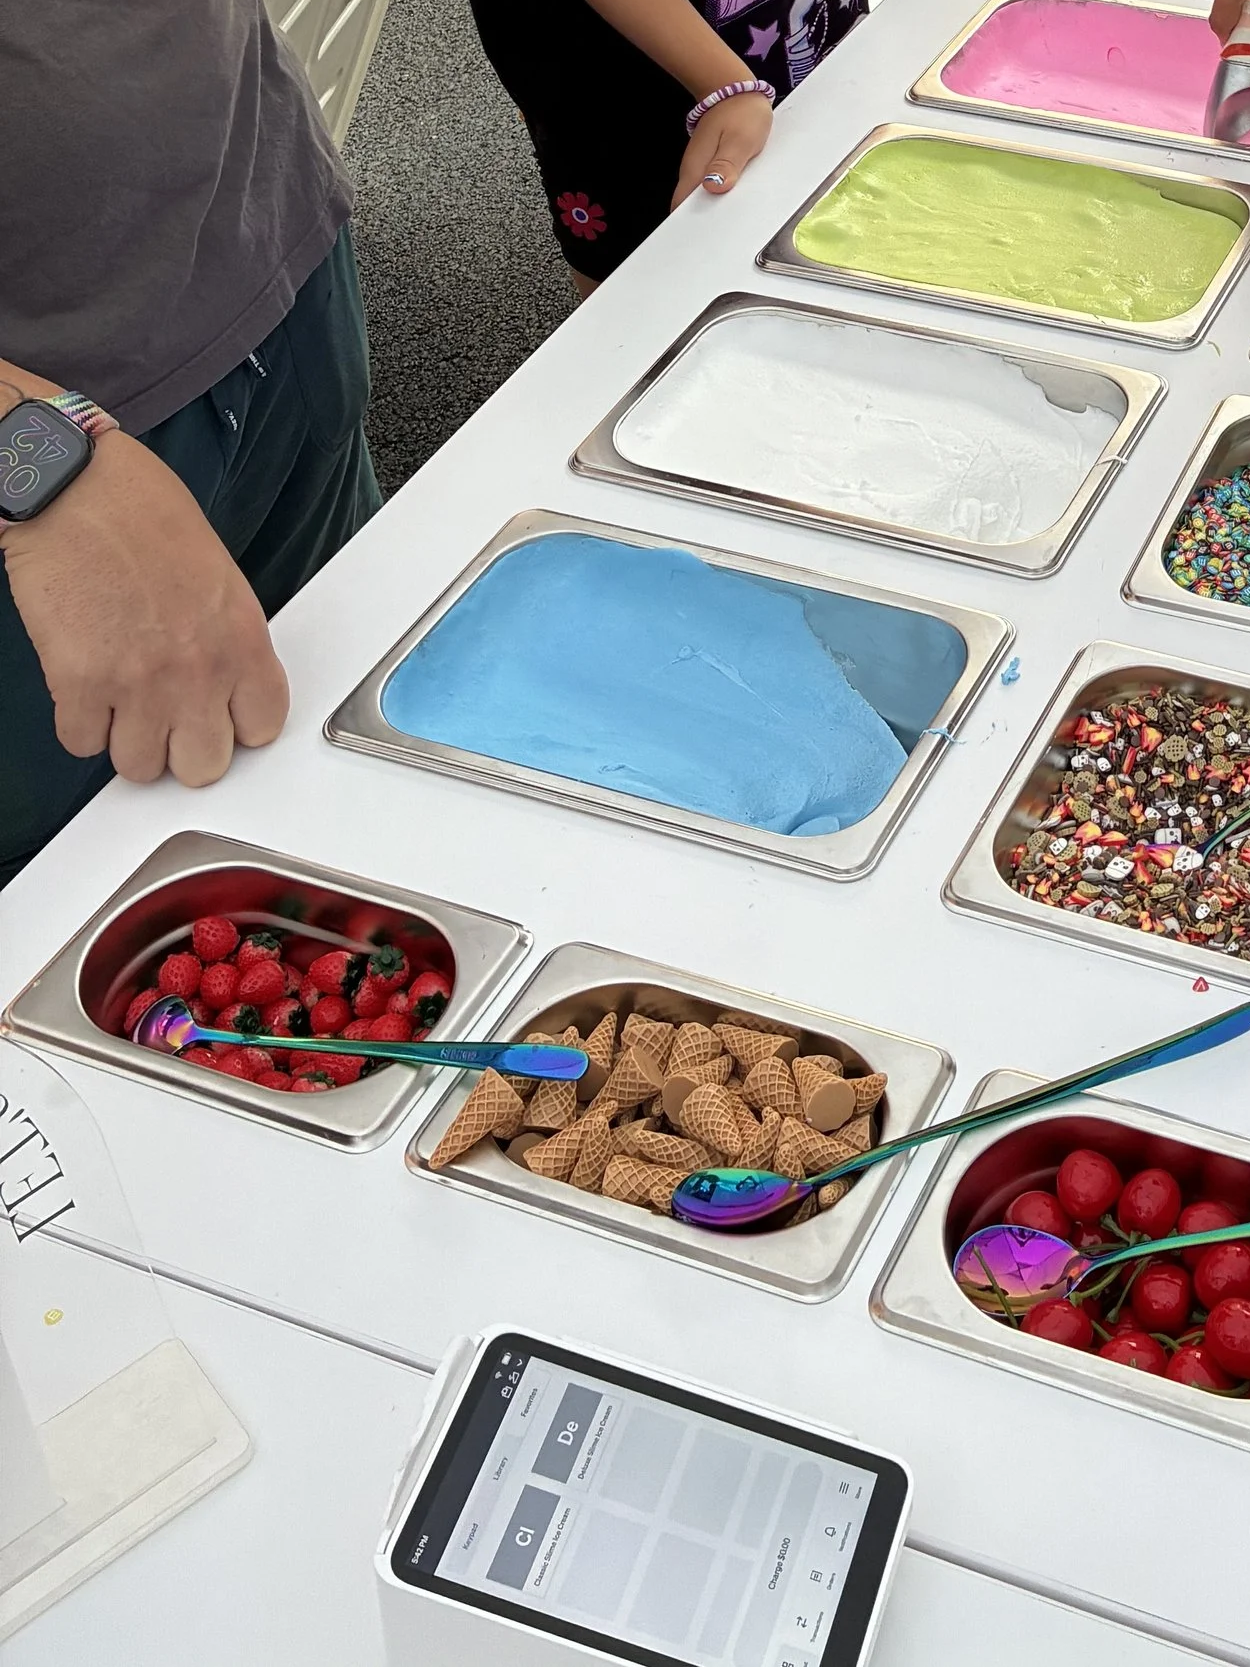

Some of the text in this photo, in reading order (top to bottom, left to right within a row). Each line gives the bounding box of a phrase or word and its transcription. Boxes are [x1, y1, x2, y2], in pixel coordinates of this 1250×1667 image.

[11, 416, 69, 465] 42
[520, 1387, 538, 1418] Favorites
[557, 1420, 579, 1445] De
[577, 1456, 592, 1479] Deluxe
[587, 1437, 600, 1456] Slime
[600, 1405, 613, 1426] Cream
[493, 1456, 508, 1481] Library
[411, 1534, 429, 1565] 5:42 PM
[462, 1522, 478, 1550] Keypad
[534, 1561, 549, 1586] Classic
[544, 1541, 557, 1562] Slime
[557, 1507, 571, 1530] Cream
[768, 1537, 791, 1590] Charge $0.00
[826, 1572, 837, 1591] Orders
[810, 1611, 824, 1643] Transactions
